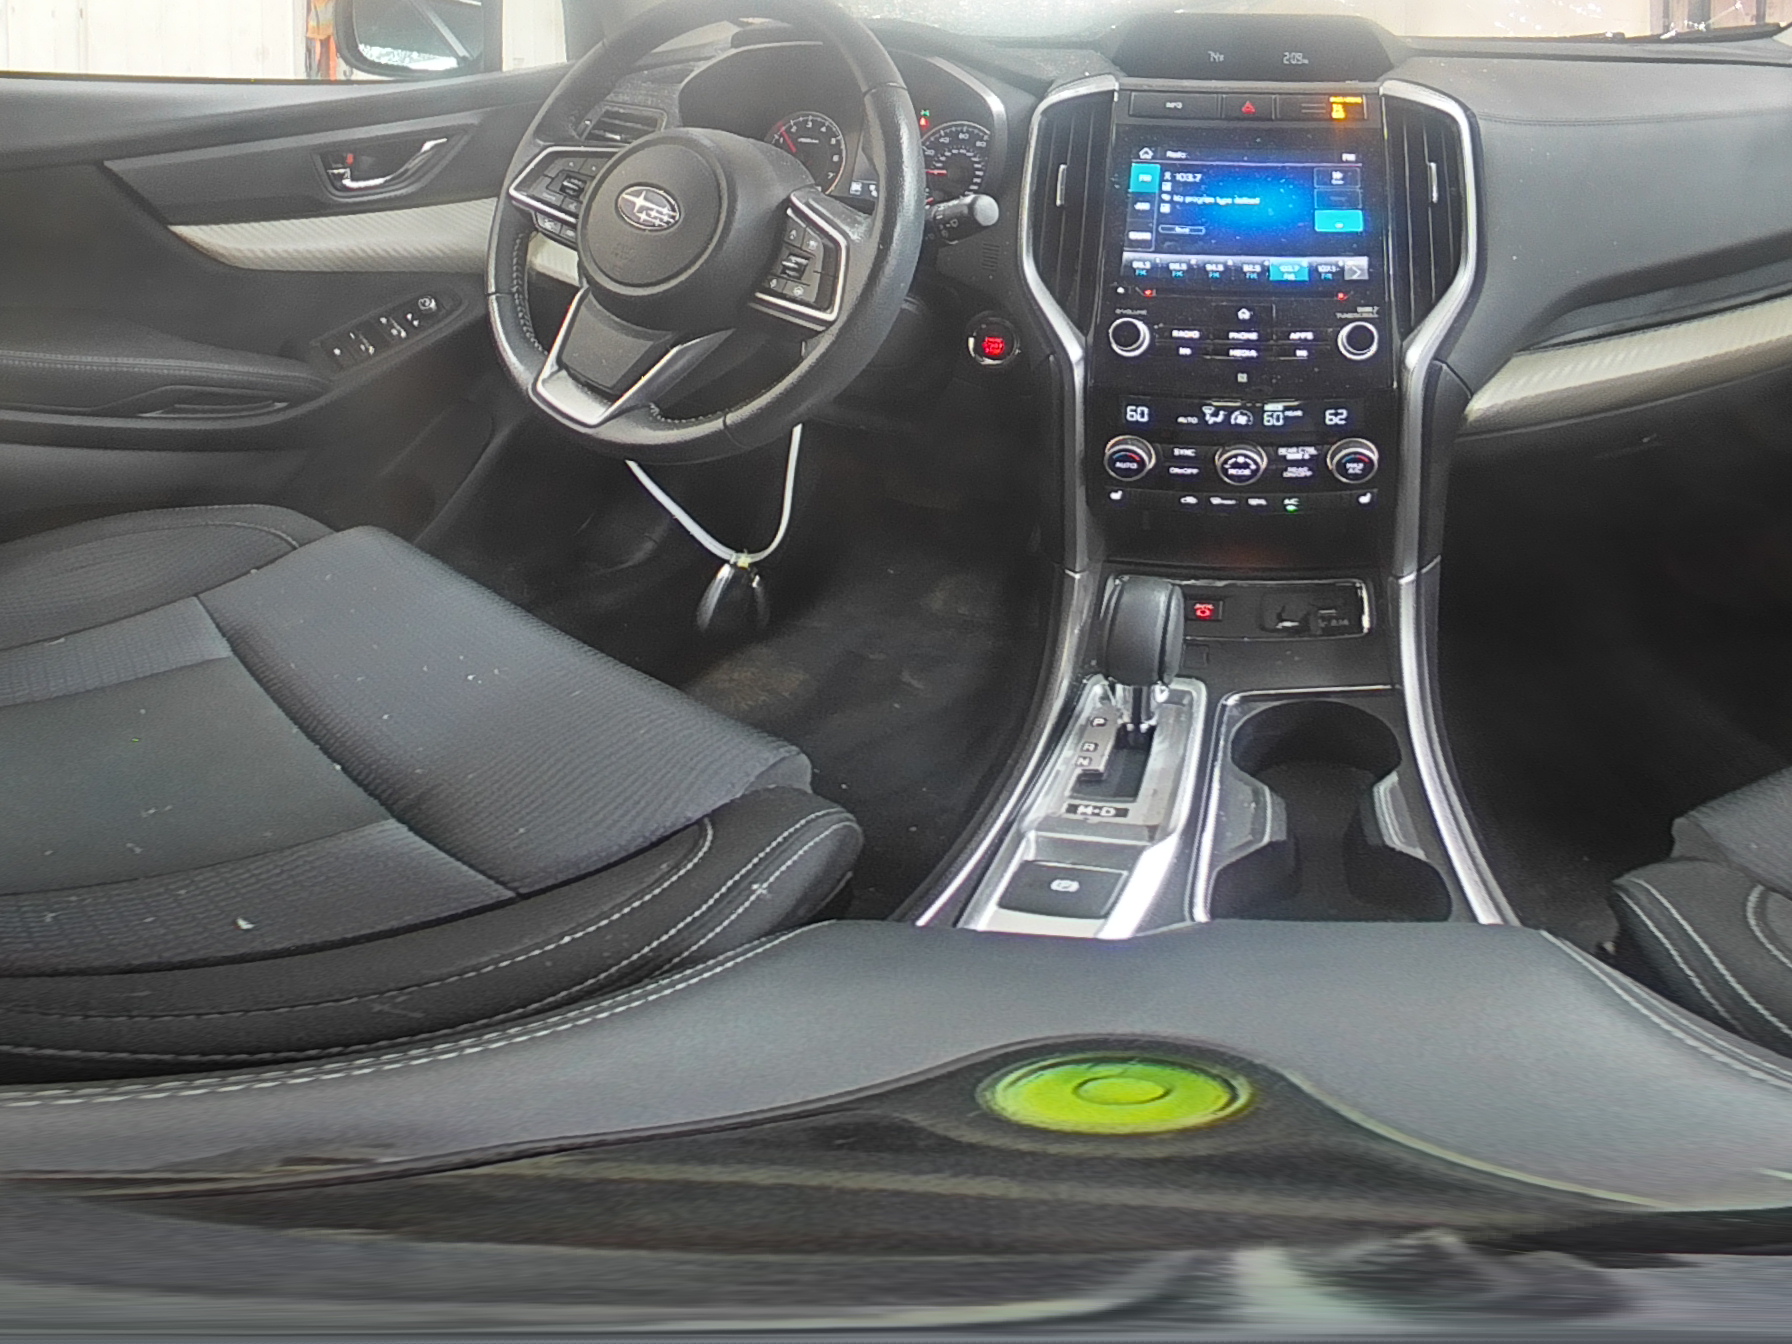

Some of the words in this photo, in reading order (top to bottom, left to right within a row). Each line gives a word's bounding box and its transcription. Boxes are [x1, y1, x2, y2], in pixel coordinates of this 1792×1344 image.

[1174, 173, 1202, 183] 103.7
[1172, 330, 1200, 338] RADIO
[1229, 332, 1259, 340] PHONE
[1289, 332, 1314, 340] APPS
[1229, 349, 1258, 357] MEDIA
[1126, 406, 1149, 422] 60
[1325, 409, 1348, 425] 62
[1263, 412, 1284, 426] 60
[1173, 448, 1196, 456] SYNC
[1228, 468, 1252, 476] MODE
[1093, 718, 1105, 727] P
[1083, 743, 1095, 751] R
[1076, 758, 1089, 766] N
